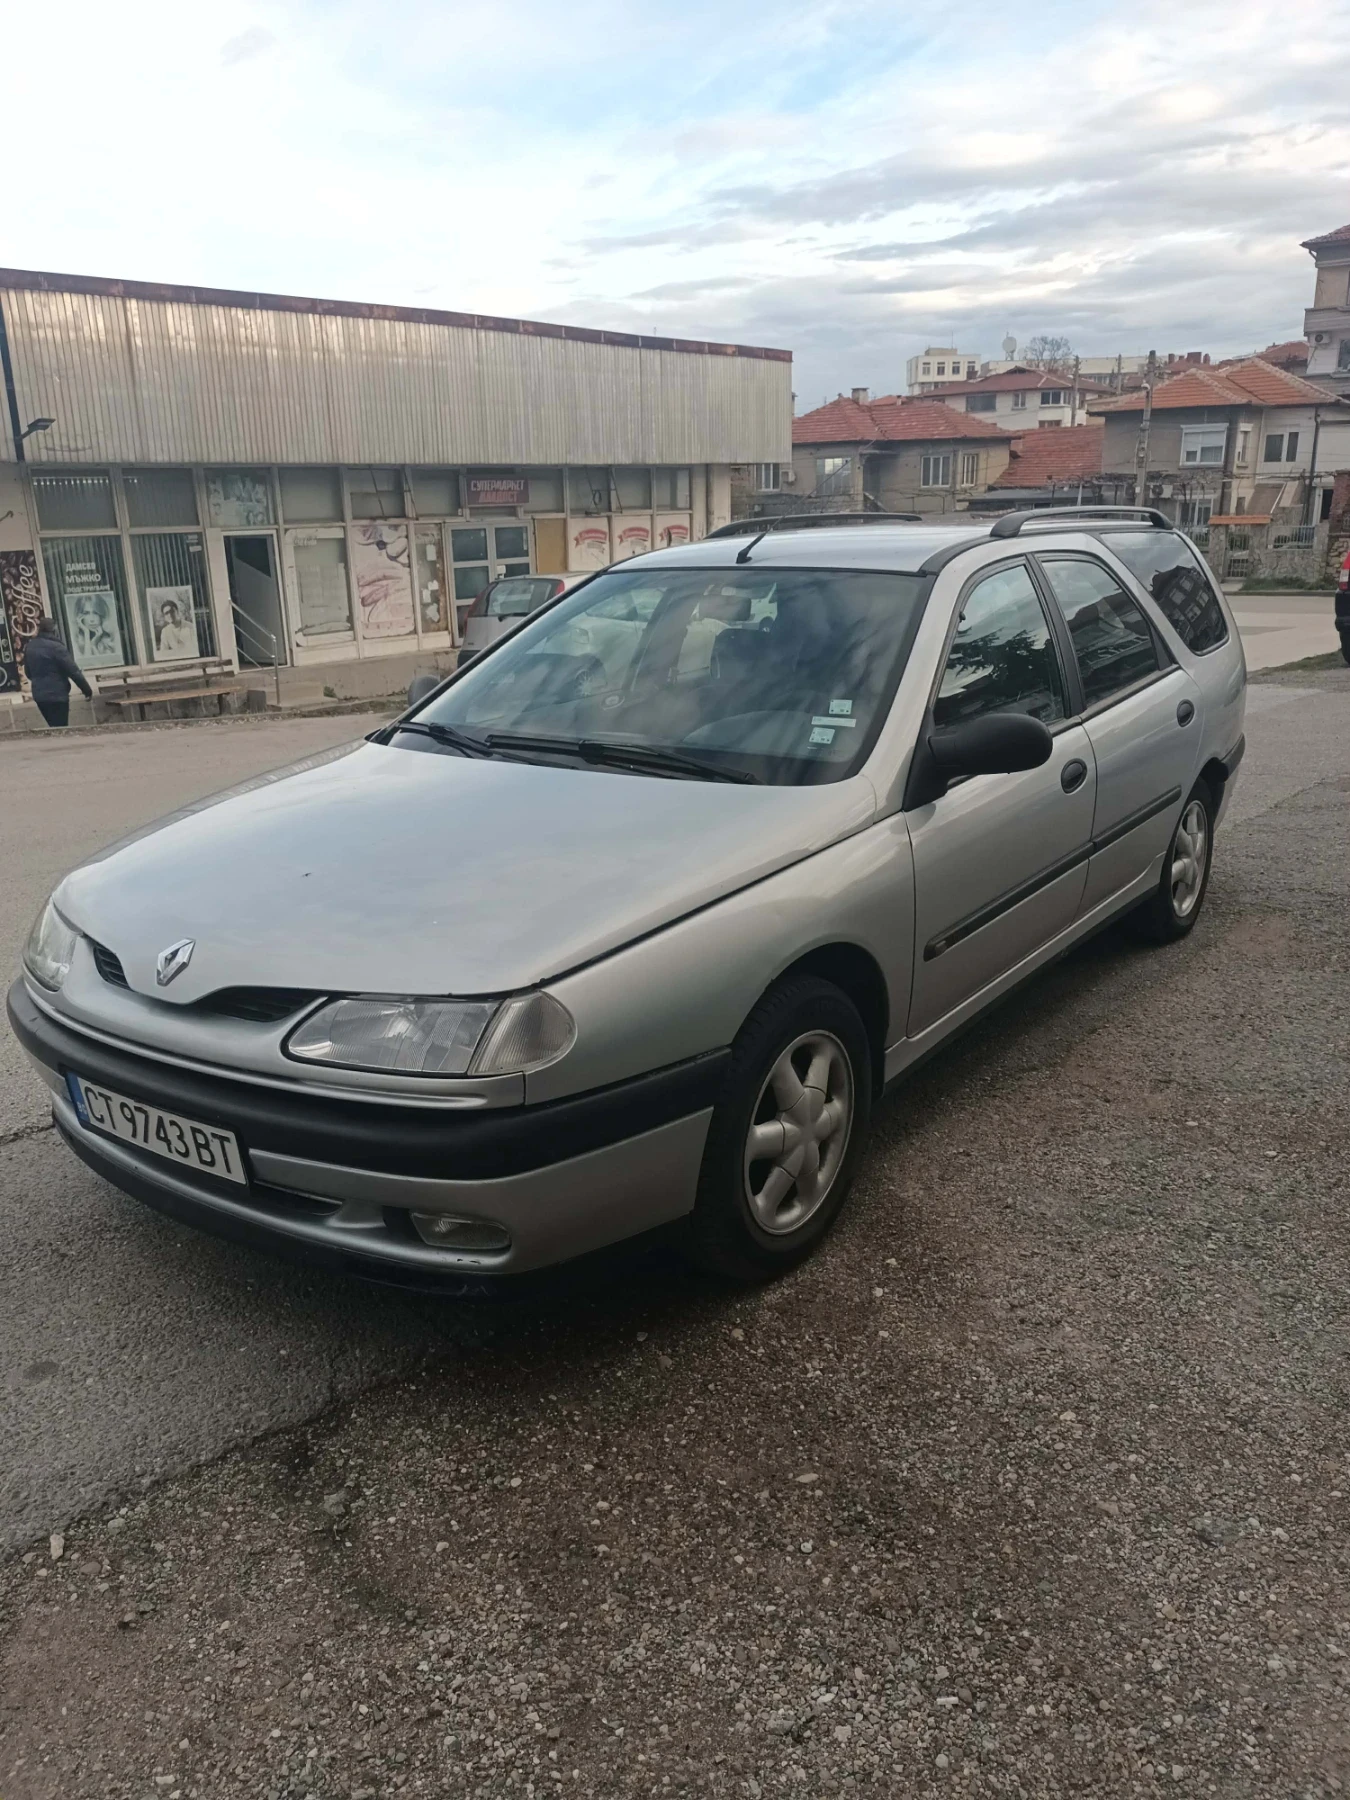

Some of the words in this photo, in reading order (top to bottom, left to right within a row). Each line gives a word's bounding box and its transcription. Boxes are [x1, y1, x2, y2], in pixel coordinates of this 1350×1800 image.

[471, 479, 525, 491] СУПЕРМАРКЕТ
[65, 562, 96, 573] ДАМСКО
[65, 573, 101, 584] МЪЖКО
[11, 564, 42, 636] Coffee
